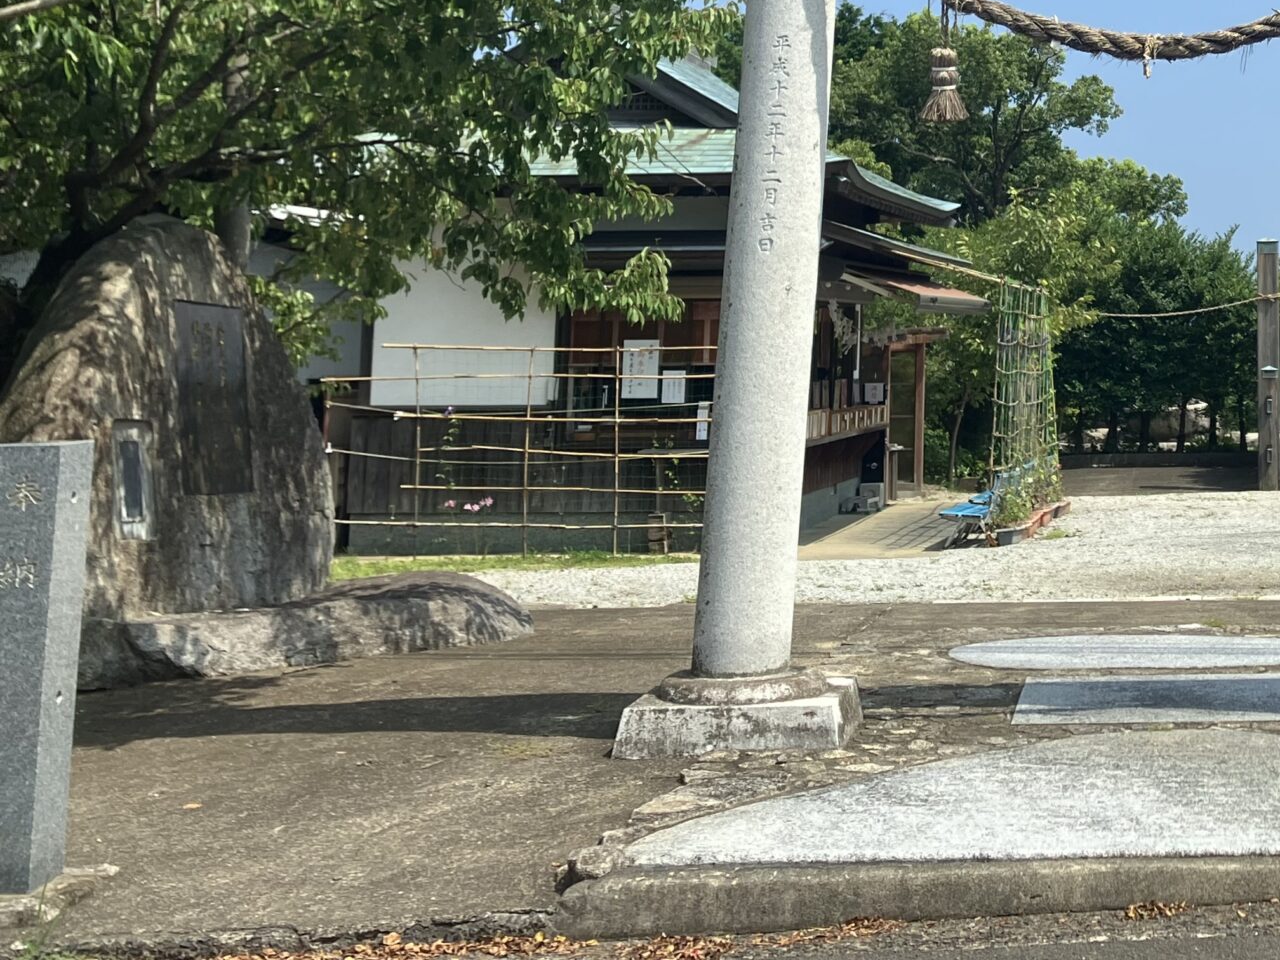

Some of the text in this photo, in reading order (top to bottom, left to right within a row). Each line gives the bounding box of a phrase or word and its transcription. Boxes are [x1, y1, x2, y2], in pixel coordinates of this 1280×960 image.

[758, 35, 792, 252] 平成十二年十二月吉日
